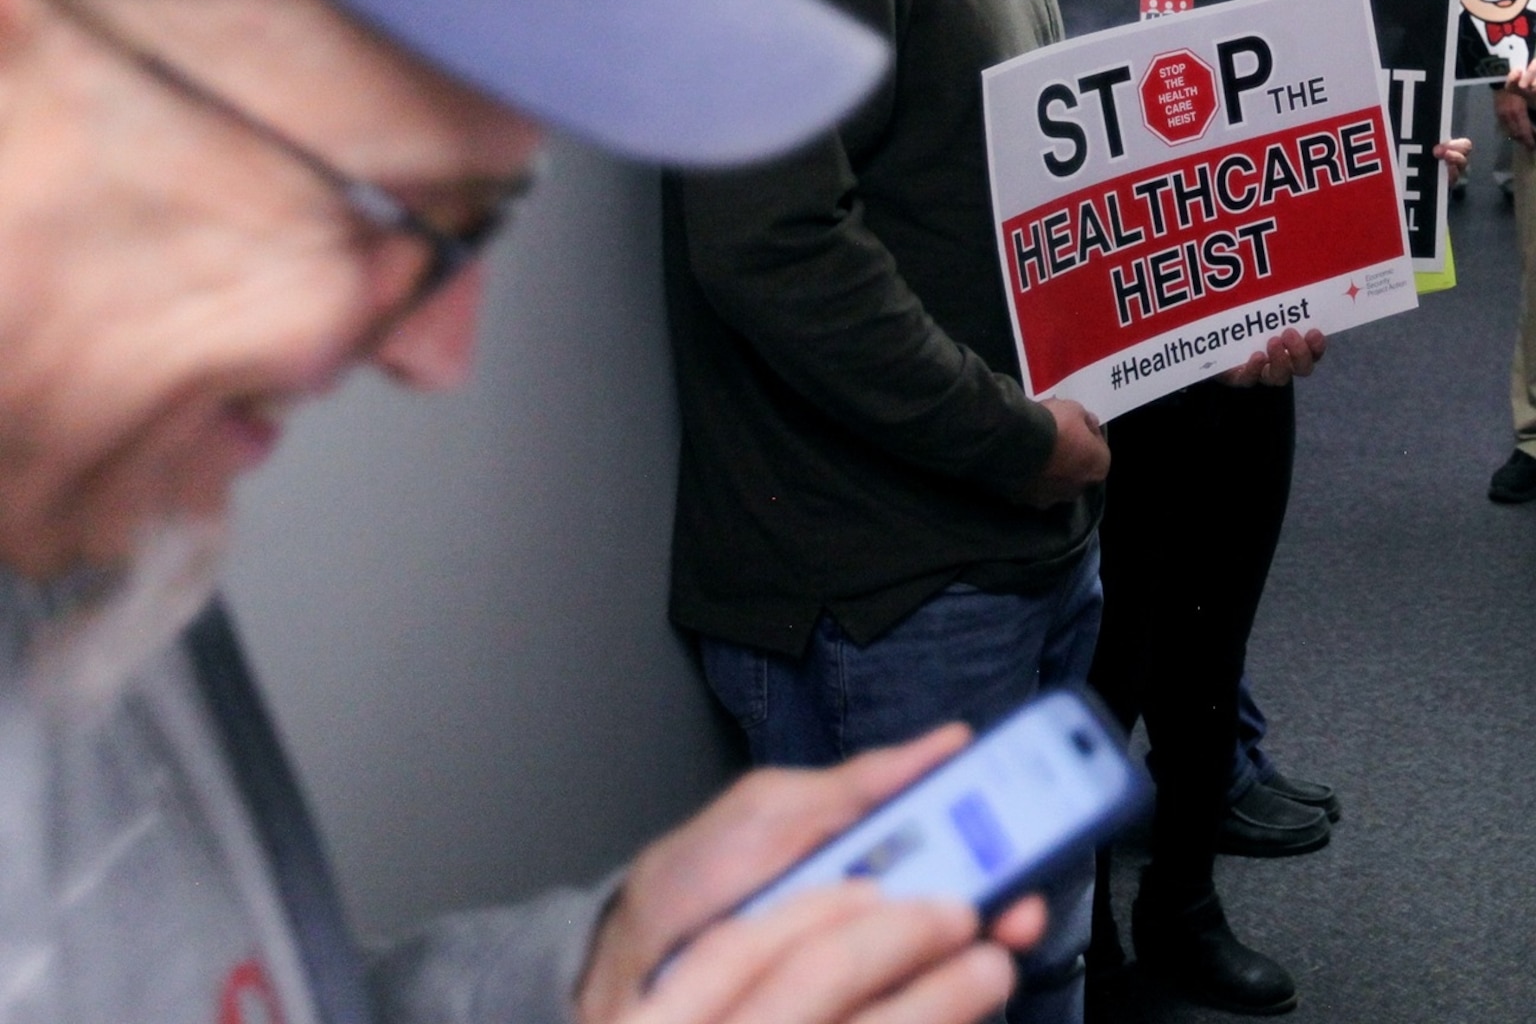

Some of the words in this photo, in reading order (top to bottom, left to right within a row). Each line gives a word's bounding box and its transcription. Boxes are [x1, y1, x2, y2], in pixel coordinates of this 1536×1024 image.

[1159, 63, 1186, 78] STOP
[1165, 77, 1185, 89] THE
[1158, 86, 1198, 104] HEALTH
[1037, 35, 1274, 177] STOP
[1267, 77, 1329, 115] THE
[1165, 100, 1193, 115] CARE
[1168, 112, 1196, 128] HEIST
[1011, 119, 1383, 293] HEALTHCARE
[1110, 217, 1277, 328] HEIST
[1111, 298, 1310, 389] #HealthcareHeist
